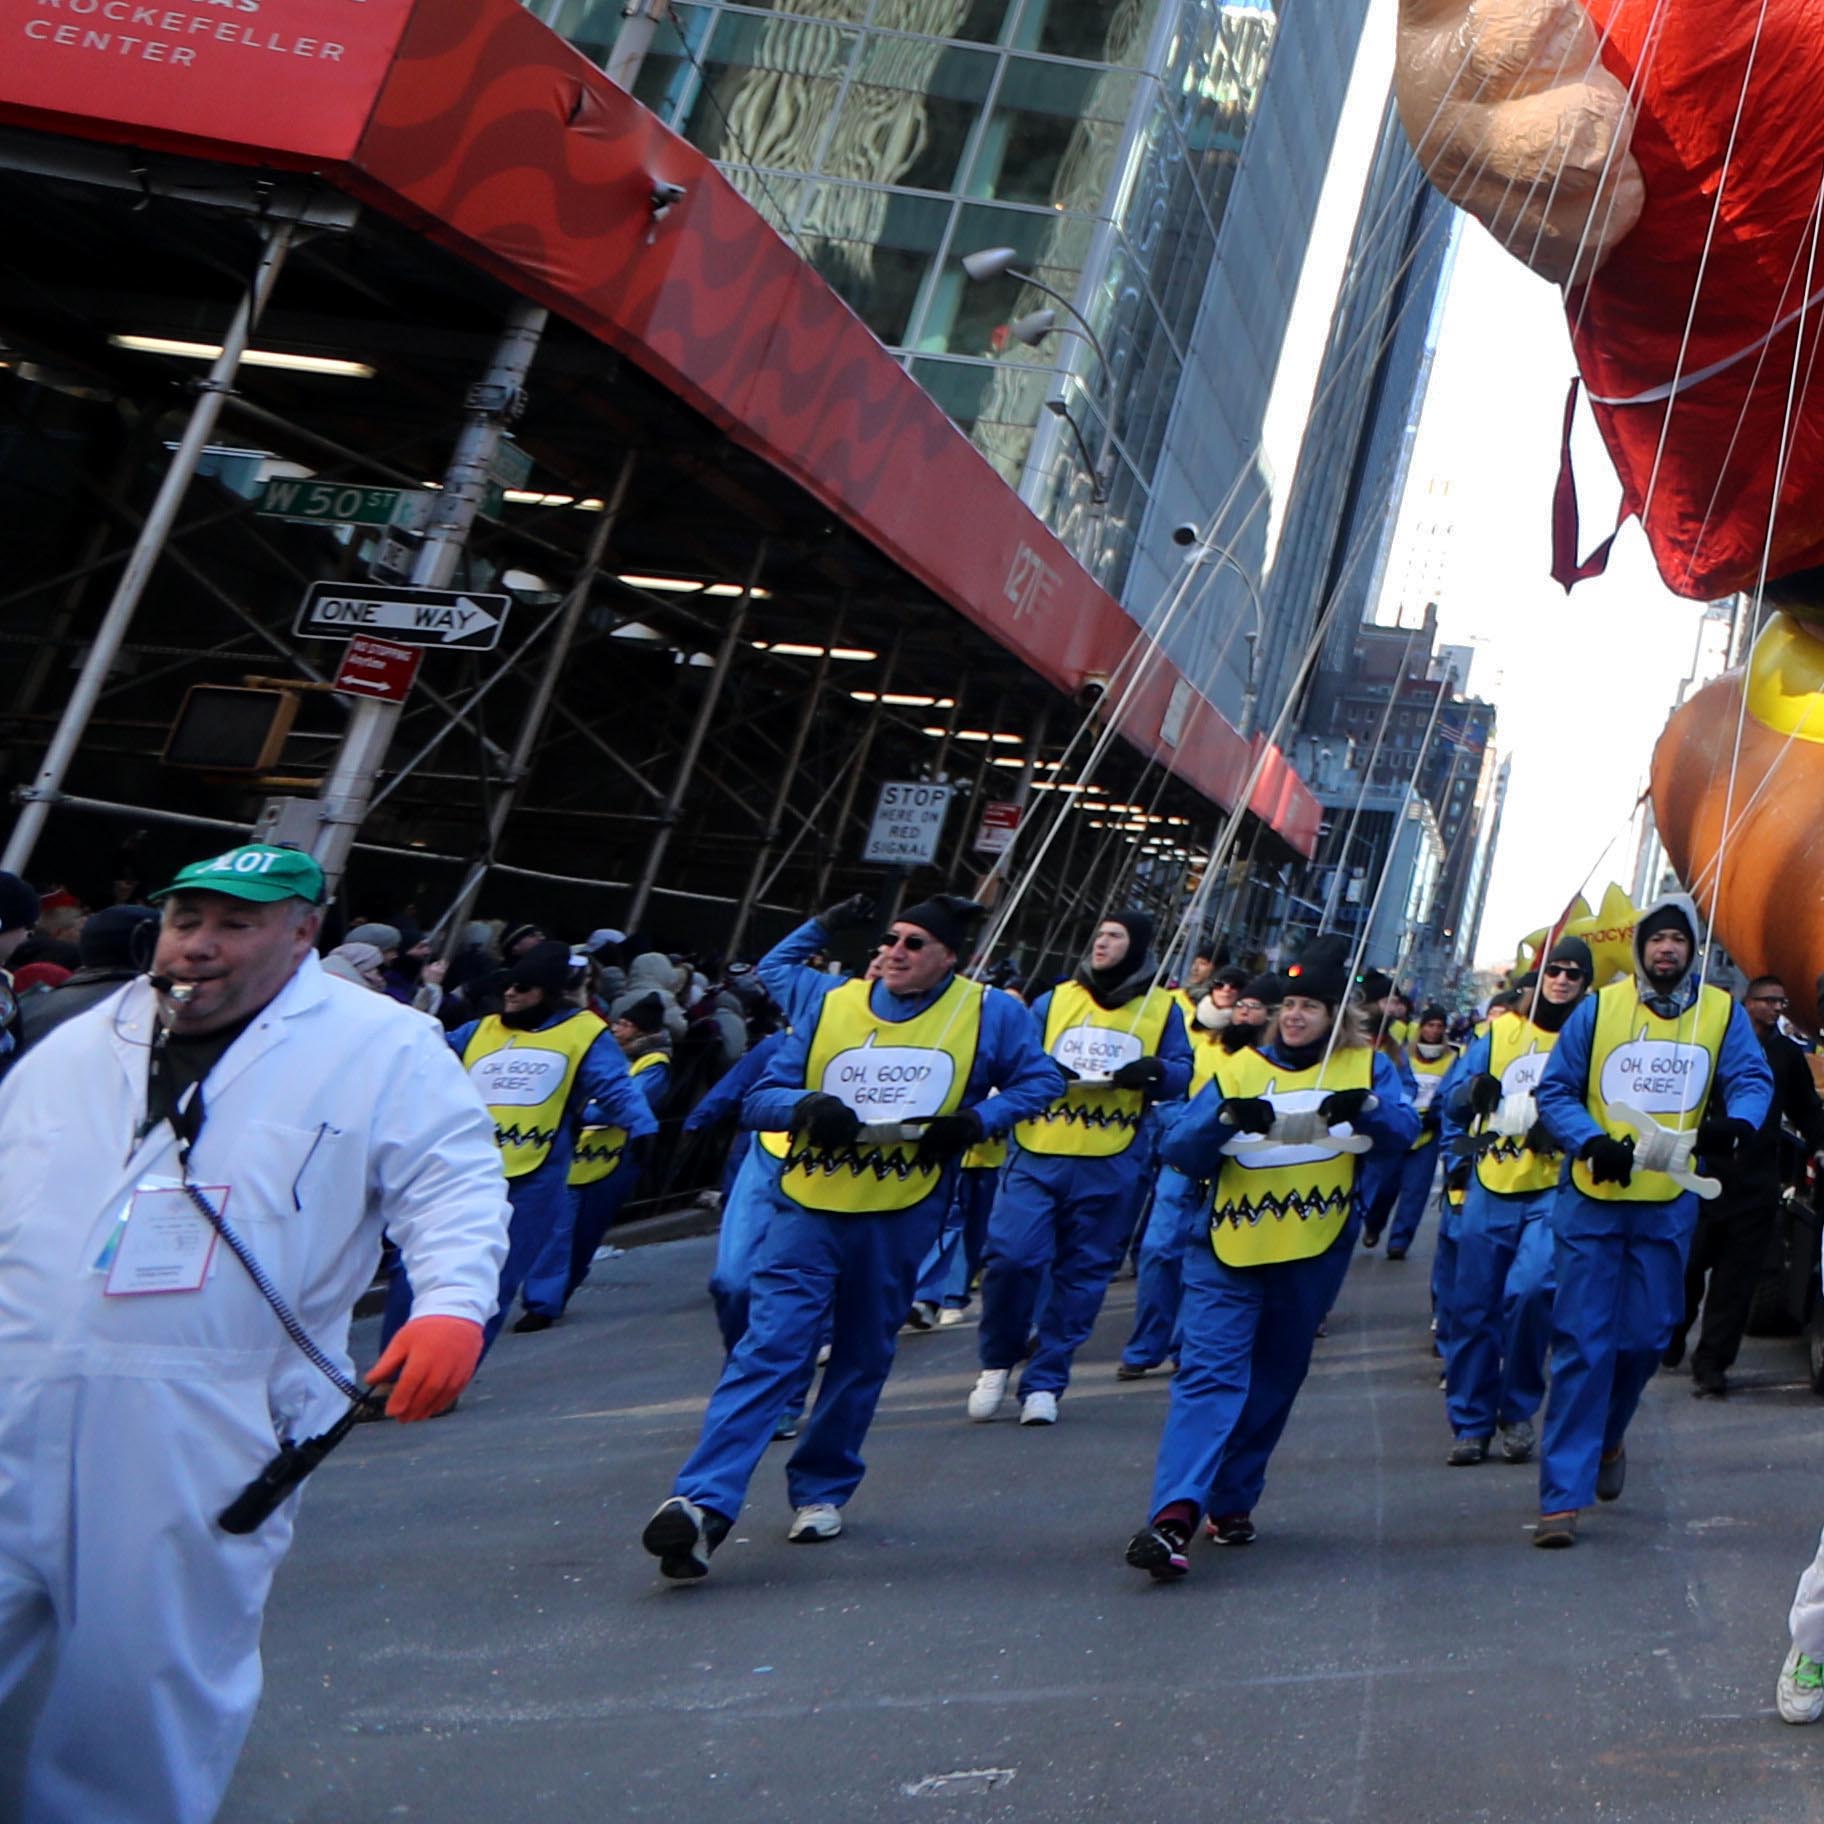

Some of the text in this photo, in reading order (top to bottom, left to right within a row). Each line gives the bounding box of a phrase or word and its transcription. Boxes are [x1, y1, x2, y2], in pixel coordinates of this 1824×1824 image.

[24, 19, 197, 66] CENTER
[263, 481, 399, 518] W 50 ST
[320, 601, 477, 630] ONE WAY
[884, 787, 946, 806] STOP
[879, 808, 940, 823] HERE ON
[888, 826, 920, 839] RED
[871, 841, 929, 856] SIGNAL
[877, 1065, 932, 1082] GOOD
[1651, 1058, 1694, 1074] GOOD
